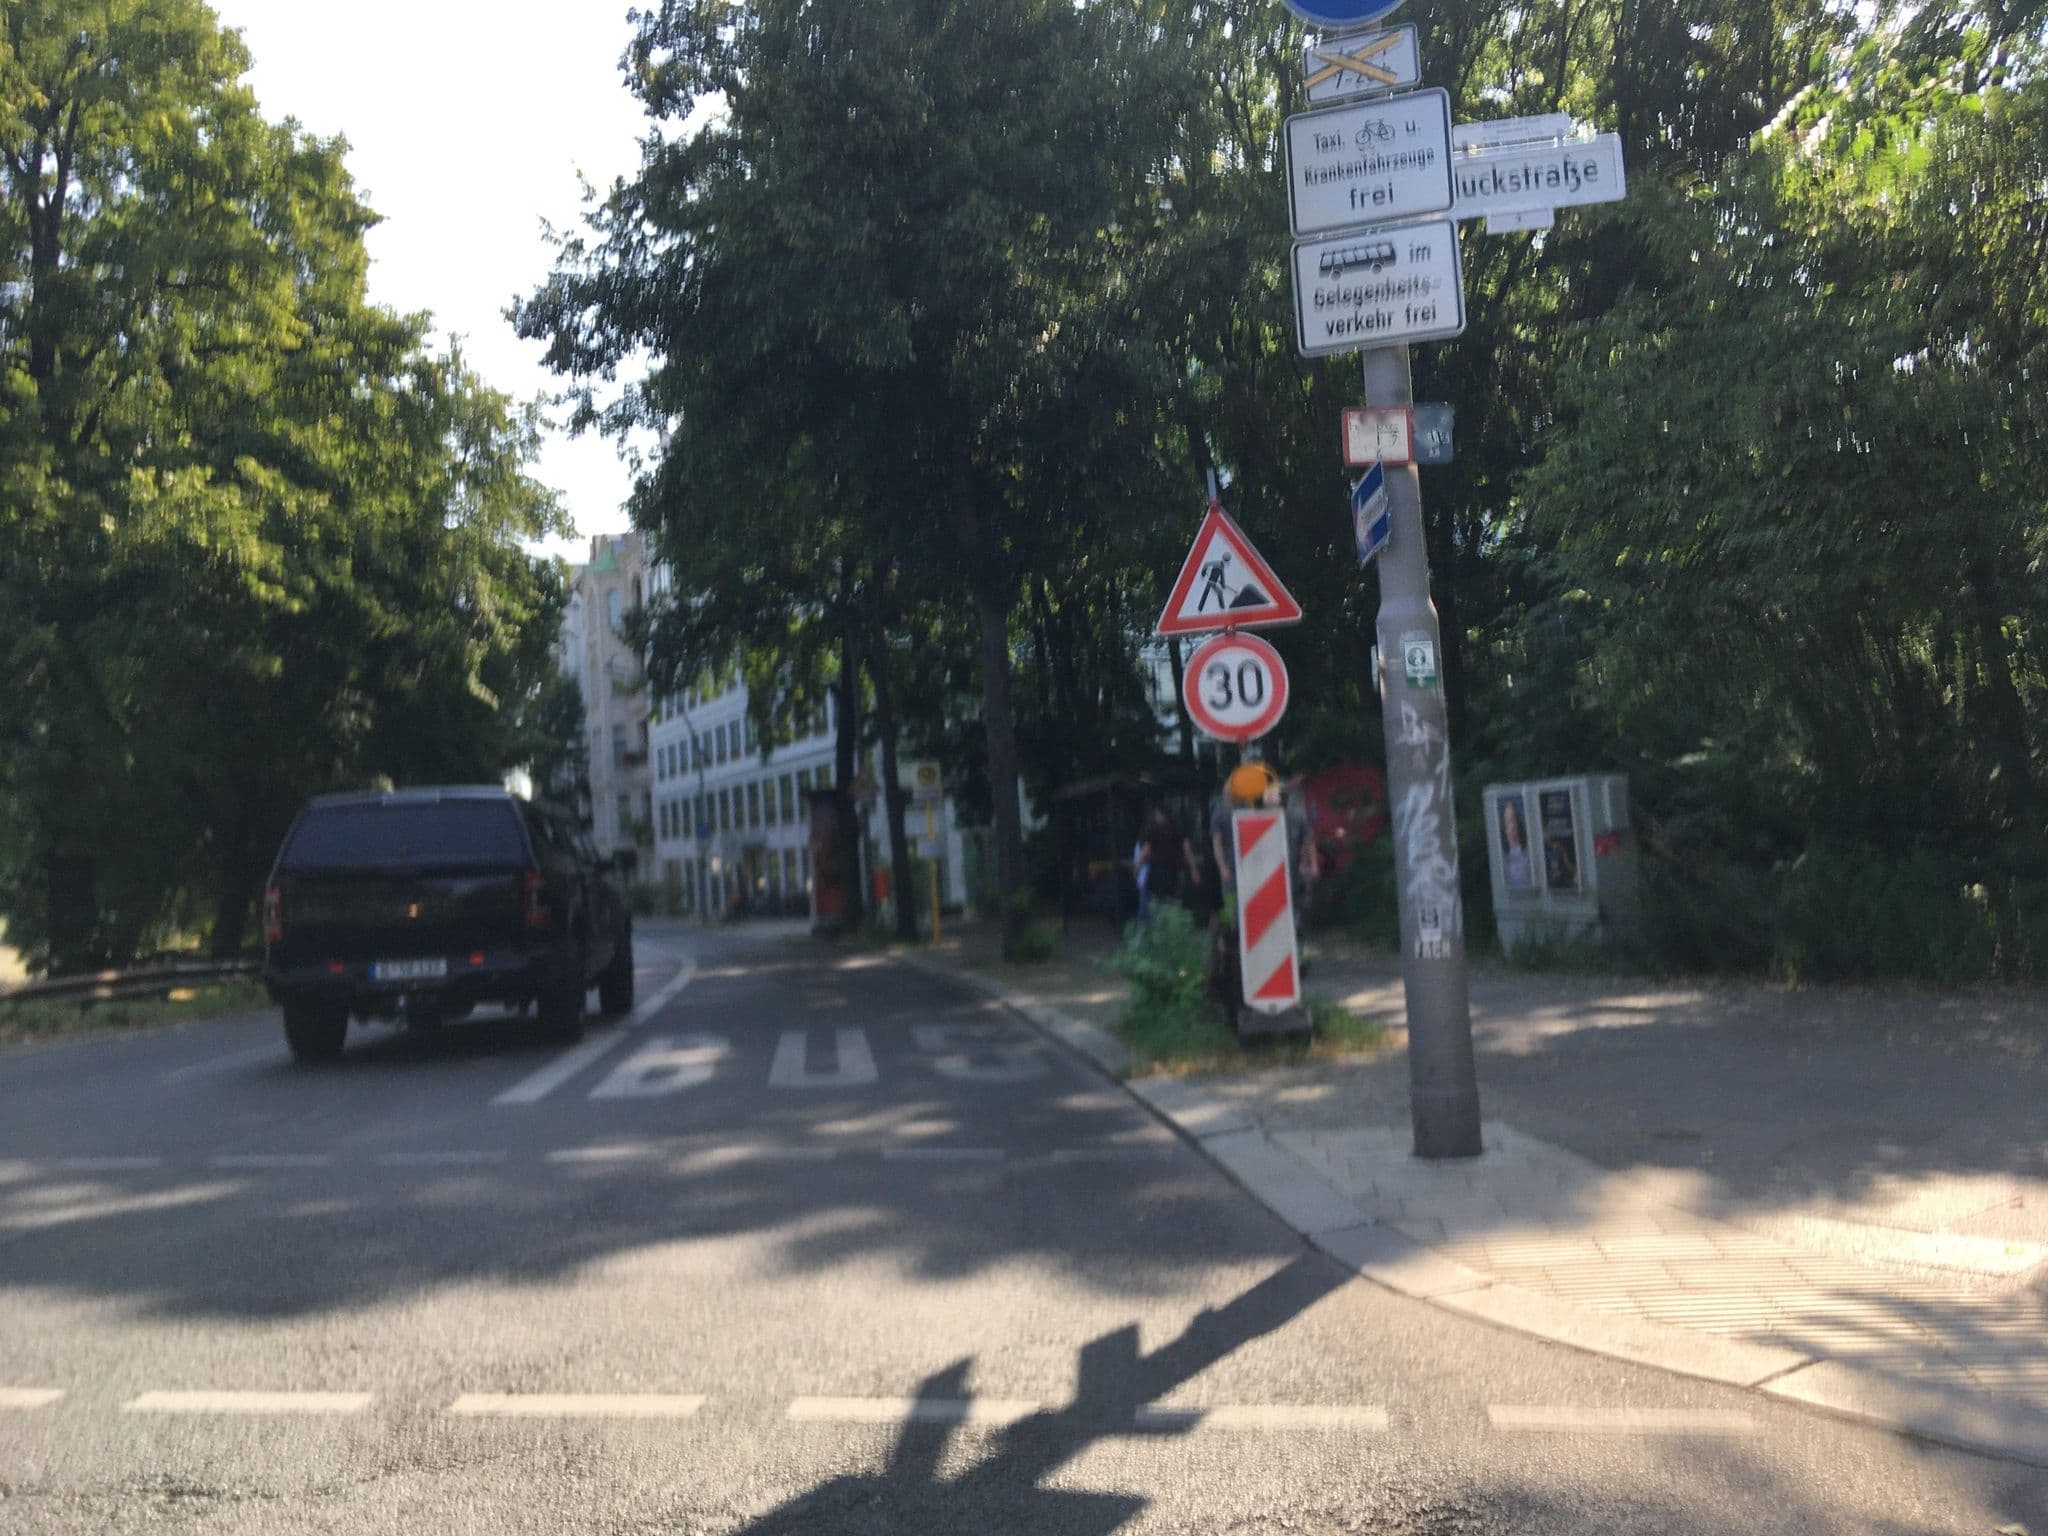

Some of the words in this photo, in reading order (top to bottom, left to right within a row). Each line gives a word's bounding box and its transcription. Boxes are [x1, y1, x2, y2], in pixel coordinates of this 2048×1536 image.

[1304, 147, 1435, 187] Krankenfahrzeuge
[1454, 153, 1599, 199] luckstraße
[1350, 182, 1394, 210] frei
[1409, 243, 1431, 264] im
[1325, 308, 1395, 336] verkehr
[1405, 300, 1436, 326] frei
[1206, 659, 1264, 710] 30
[588, 1022, 1056, 1100] BUS
